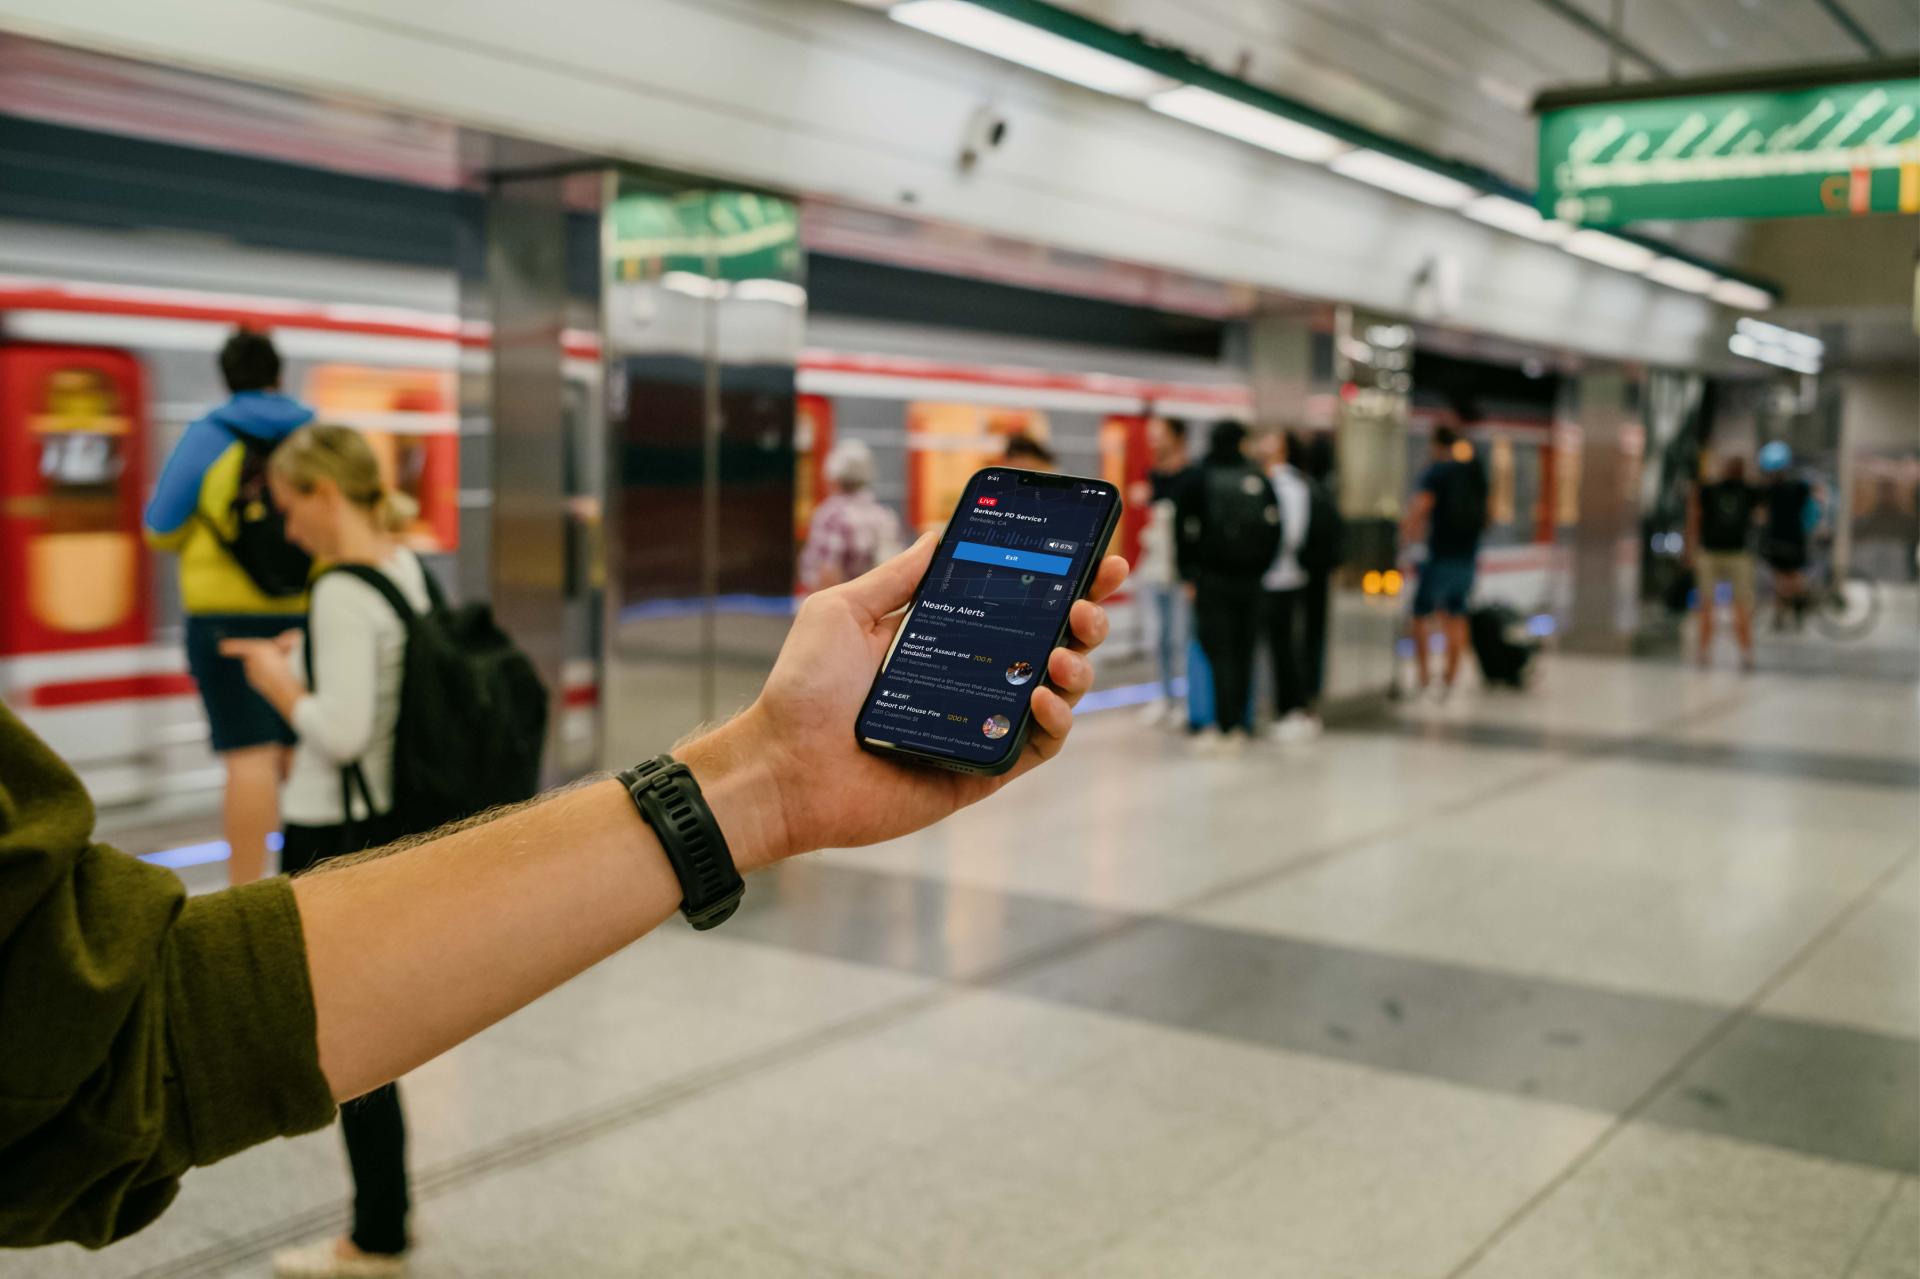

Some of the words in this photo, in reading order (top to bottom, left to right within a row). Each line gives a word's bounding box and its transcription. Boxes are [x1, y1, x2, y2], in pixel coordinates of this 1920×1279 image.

[973, 508, 1003, 517] Berkeley
[1016, 514, 1042, 522] Service
[921, 600, 956, 613] Nearby
[957, 606, 986, 617] Alerts
[900, 649, 932, 658] Vandalism
[903, 642, 925, 651] Report
[934, 648, 957, 656] Assault
[875, 700, 898, 709] Report
[906, 706, 927, 714] House
